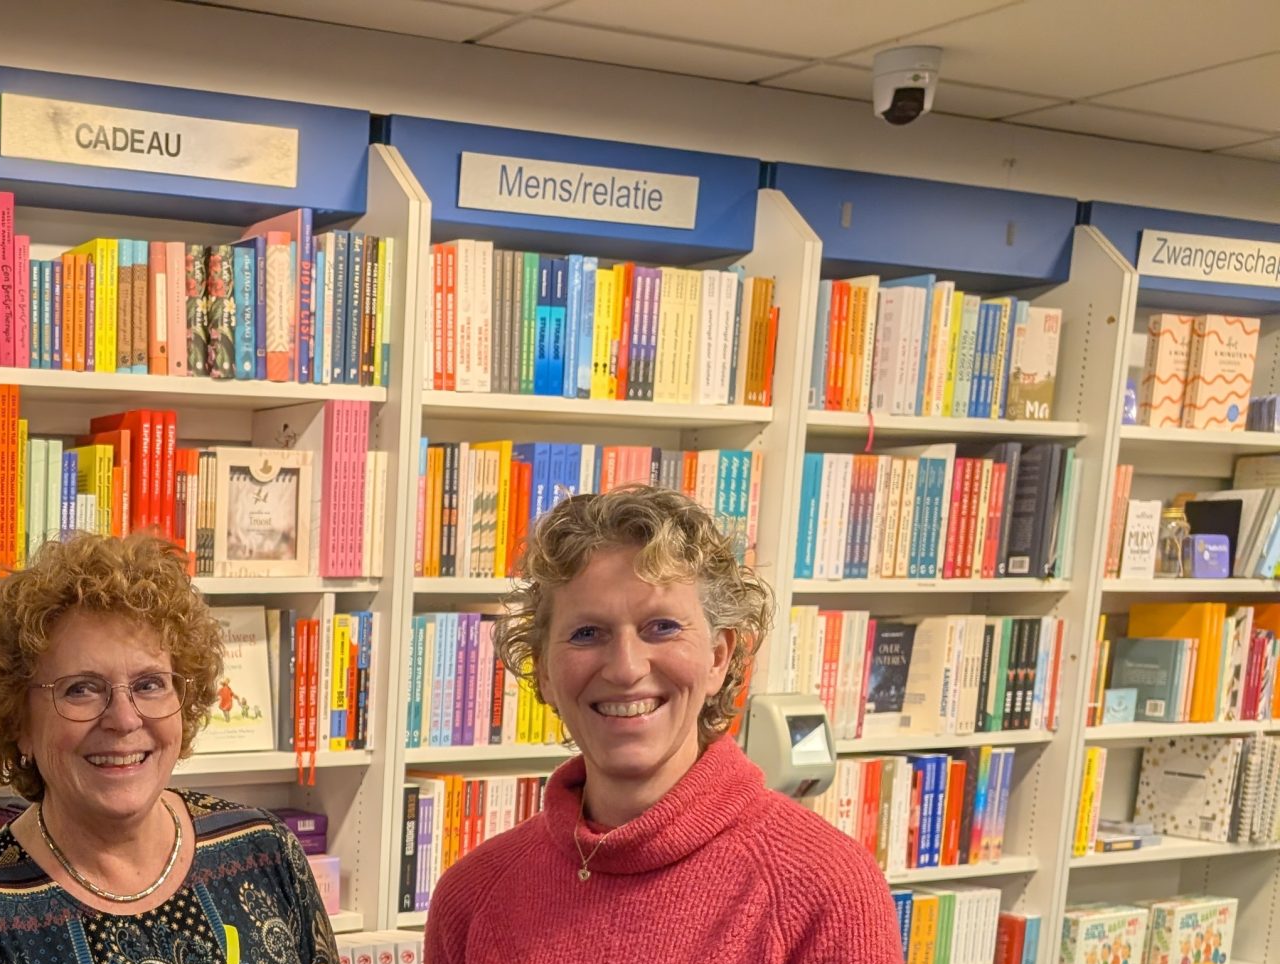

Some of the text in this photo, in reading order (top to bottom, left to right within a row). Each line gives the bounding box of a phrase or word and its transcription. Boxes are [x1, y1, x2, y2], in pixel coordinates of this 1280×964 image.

[75, 123, 181, 157] CADEAU
[499, 163, 663, 212] Mens/relatie
[244, 307, 252, 338] VRAAG
